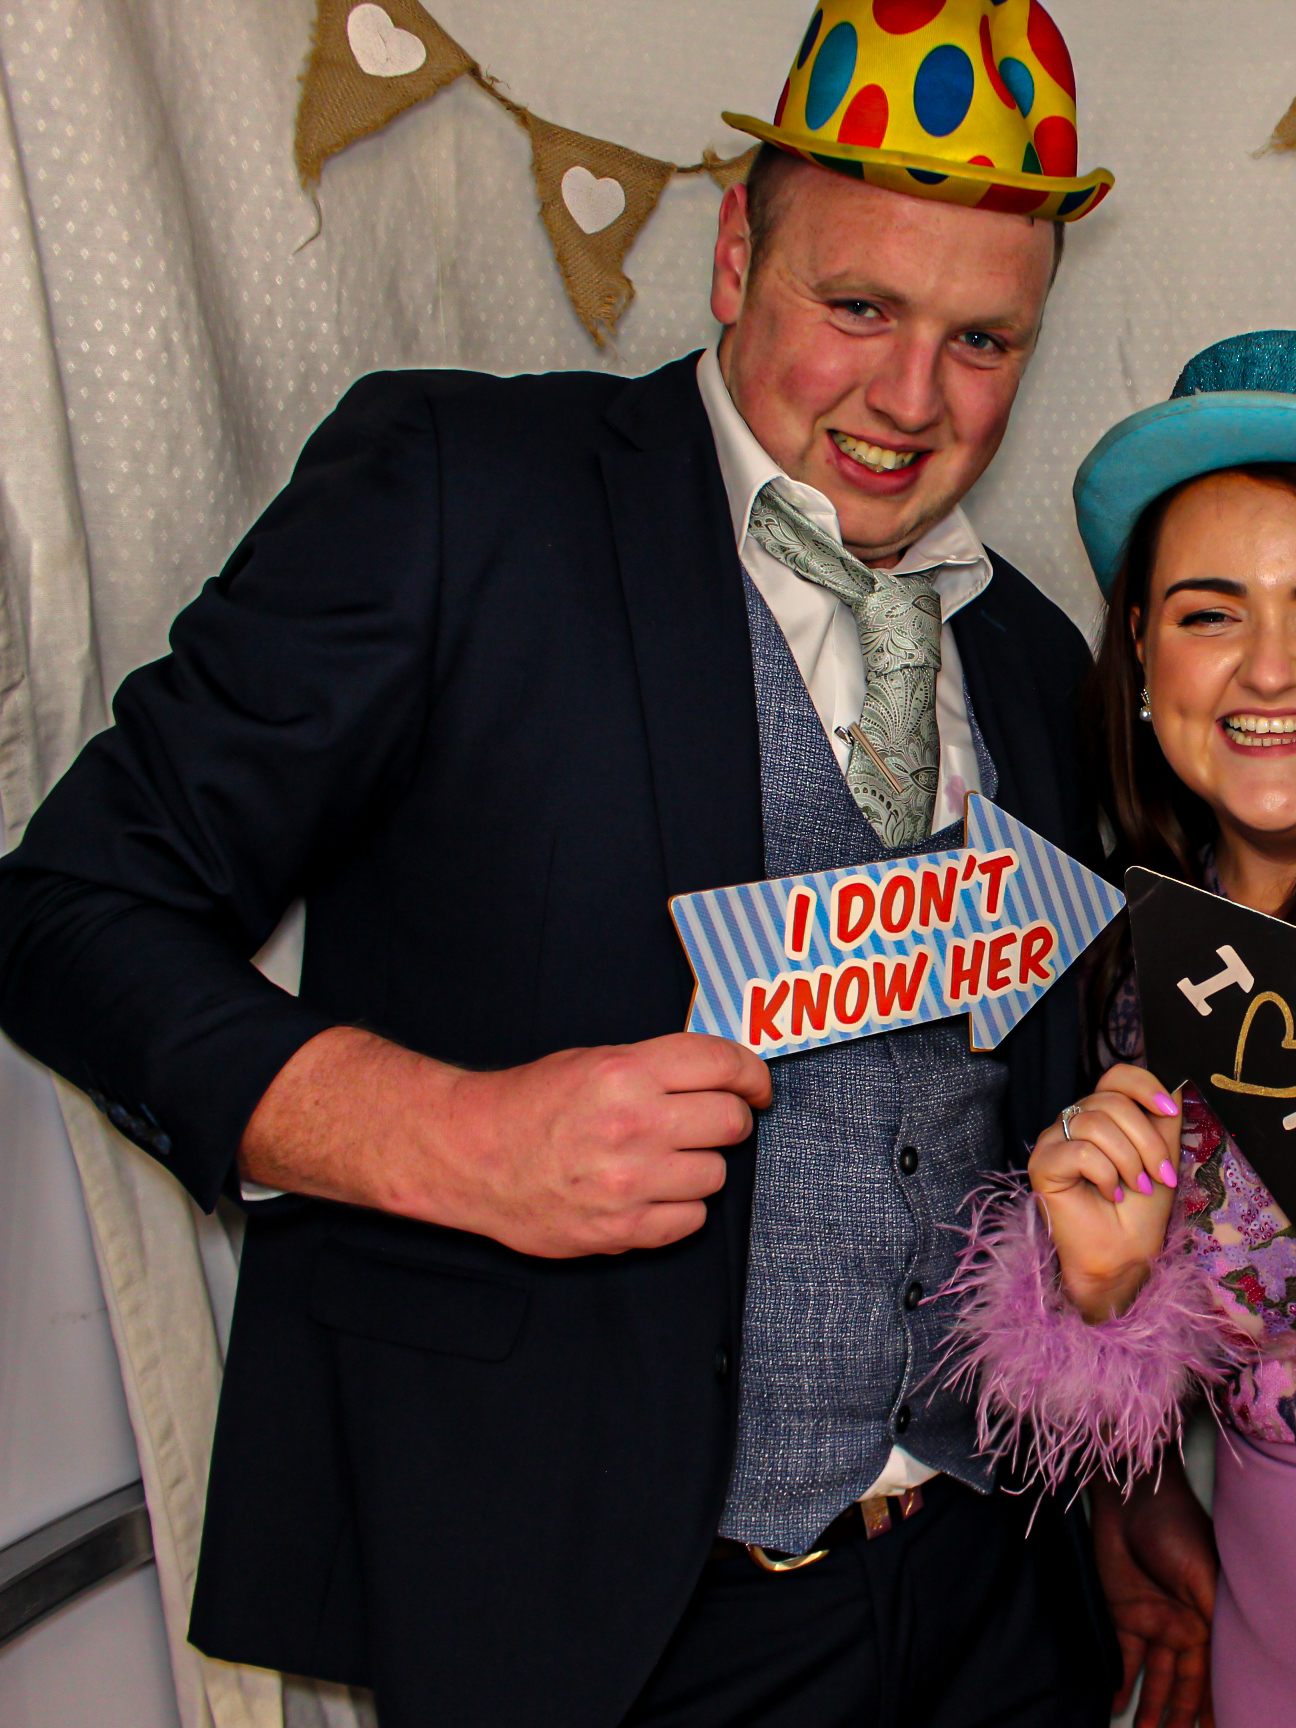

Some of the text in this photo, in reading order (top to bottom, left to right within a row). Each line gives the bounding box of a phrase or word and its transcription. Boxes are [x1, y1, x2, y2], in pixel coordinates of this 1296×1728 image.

[790, 853, 1015, 954] I DON'T
[748, 925, 1054, 1047] KNOW HER
[1176, 944, 1256, 1017] I
